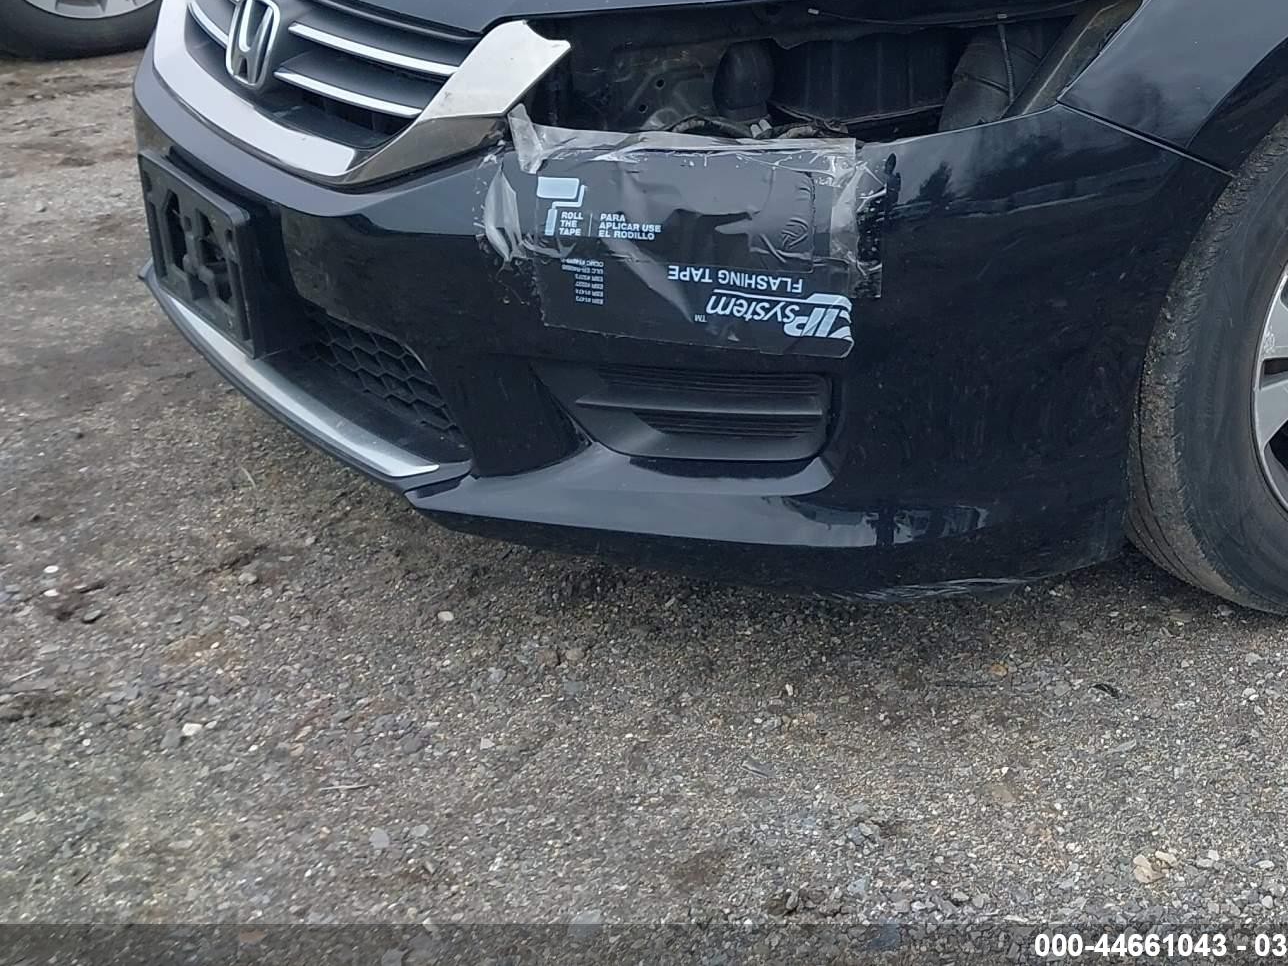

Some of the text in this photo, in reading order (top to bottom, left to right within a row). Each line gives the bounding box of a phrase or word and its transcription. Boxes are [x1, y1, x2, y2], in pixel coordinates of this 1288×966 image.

[561, 211, 583, 220] ROLL
[600, 213, 625, 222] PARA
[560, 220, 577, 228] THE
[598, 222, 661, 233] APLICAR USE
[559, 228, 581, 236] TAPE
[598, 230, 655, 240] EL RODILLO
[668, 265, 803, 293] FLASHING TAPE
[694, 314, 707, 323] TM
